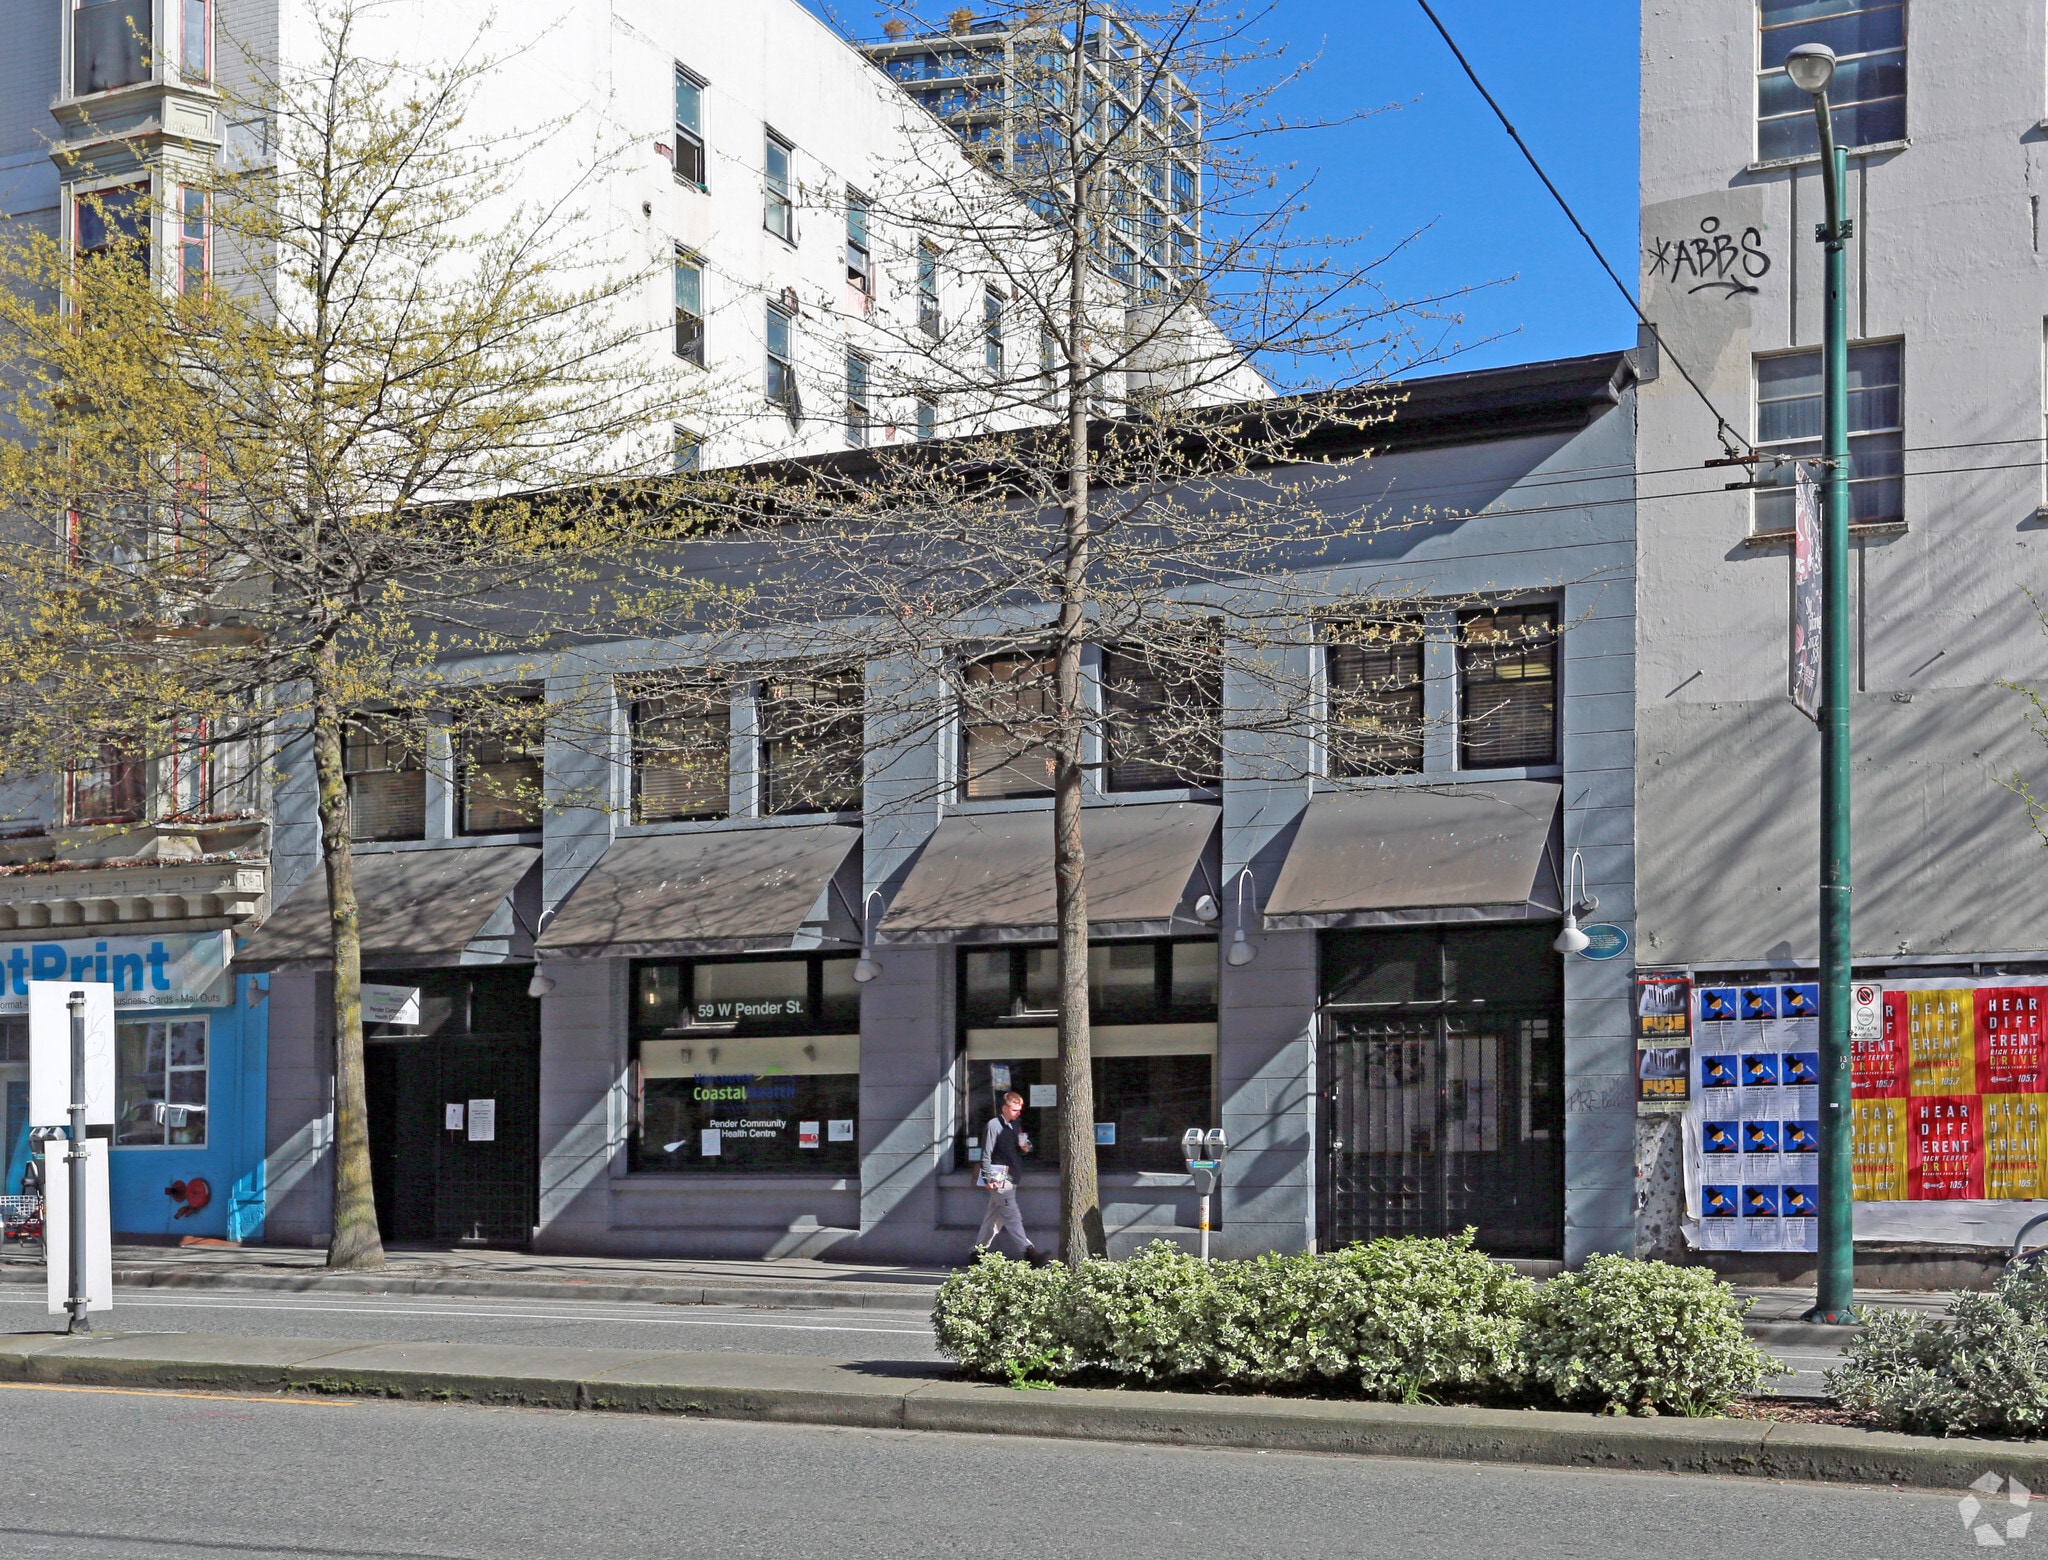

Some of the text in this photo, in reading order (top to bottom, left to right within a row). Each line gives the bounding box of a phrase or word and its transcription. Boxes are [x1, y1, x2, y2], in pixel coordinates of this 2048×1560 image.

[0, 941, 170, 996] tPrint
[149, 995, 173, 1004] Cards
[181, 994, 197, 1003] Mail
[200, 993, 220, 1002] Outs
[1989, 998, 2037, 1012] HEAR
[698, 1000, 804, 1017] 59 W Pender St.
[1912, 1002, 1958, 1016] HEAR
[1642, 1016, 1686, 1031] FUSE
[1912, 1019, 1958, 1033] DIFF
[1990, 1015, 2037, 1029] DIFF
[1912, 1037, 1959, 1051] ERENT
[1990, 1034, 2038, 1047] ERENT
[1914, 1059, 1960, 1069] MORNINGS
[1990, 1055, 2037, 1066] DRIVE
[1876, 1080, 1894, 1088] 105.7
[1941, 1077, 1960, 1086] 105.7
[2018, 1074, 2038, 1083] 105.7
[693, 1086, 747, 1100] Coastal
[1642, 1079, 1686, 1094] FUSE
[1921, 1105, 1968, 1118] HEAR
[1990, 1103, 2037, 1115] HEAR
[709, 1119, 786, 1129] Pender Community
[1922, 1122, 1968, 1135] DIFF
[1990, 1120, 2037, 1133] DIFF
[721, 1129, 776, 1138] Health Centre
[1922, 1140, 1968, 1153] ERENT
[1990, 1138, 2038, 1151] ERENT
[1922, 1162, 1969, 1172] DRIVE
[1991, 1161, 2037, 1170] MORNINGS
[1876, 1181, 1895, 1190] 105.7
[1950, 1181, 1968, 1189] 105.7
[2019, 1179, 2038, 1188] 105.7
